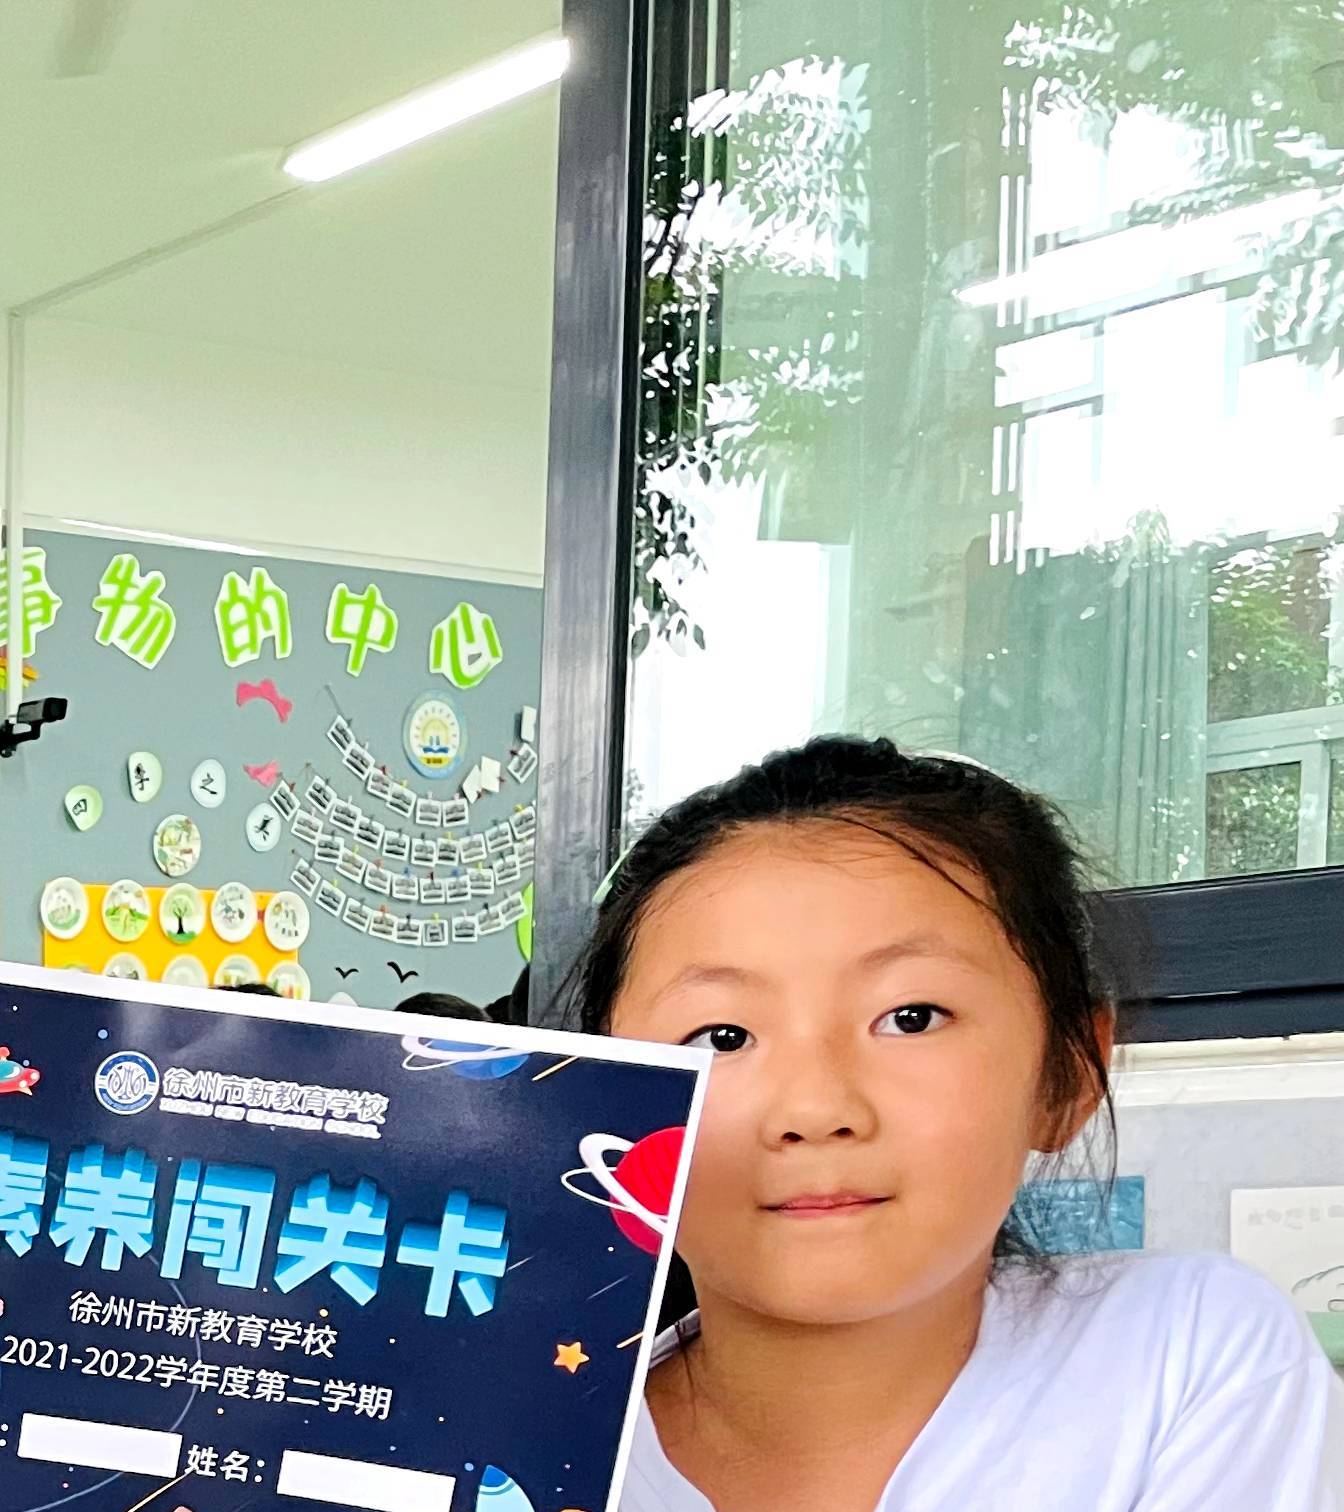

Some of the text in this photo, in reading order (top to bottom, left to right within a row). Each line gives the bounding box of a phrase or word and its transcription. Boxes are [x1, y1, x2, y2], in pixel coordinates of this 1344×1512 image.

[162, 1067, 389, 1124] 徐州市新教育学校
[68, 1290, 338, 1358] 徐州市新教育学校
[0, 1335, 393, 1420] 2021-2022学年度第二学期
